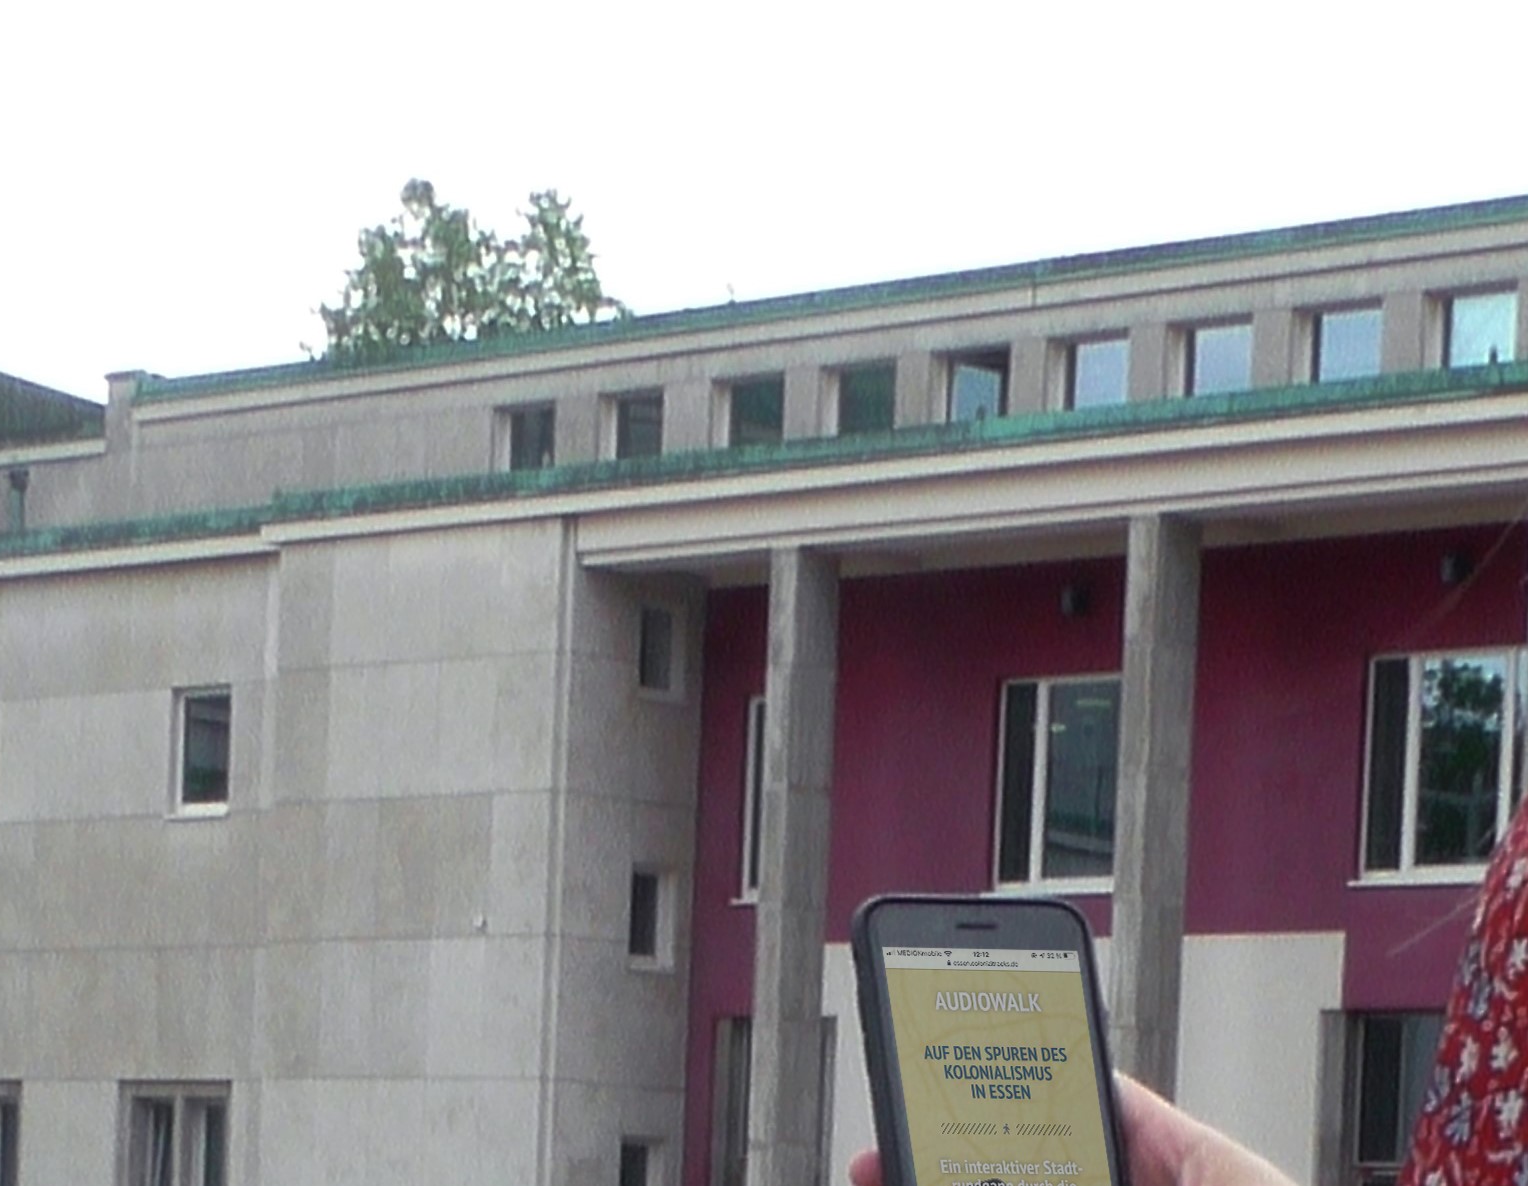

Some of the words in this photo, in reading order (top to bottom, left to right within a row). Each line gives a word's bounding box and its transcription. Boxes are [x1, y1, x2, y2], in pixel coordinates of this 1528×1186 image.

[935, 991, 1042, 1012] AUDIOWALK
[924, 1045, 949, 1060] AUF
[953, 1045, 982, 1061] DEN
[985, 1046, 1038, 1062] SPUREN
[1042, 1047, 1068, 1062] DES
[944, 1064, 1053, 1081] KOLONIALISMUS
[971, 1084, 986, 1099] IN
[989, 1084, 1032, 1100] ESSEN
[939, 1159, 961, 1174] Ein
[965, 1159, 1040, 1175] interaktiver
[1043, 1160, 1083, 1176] Stadt-
